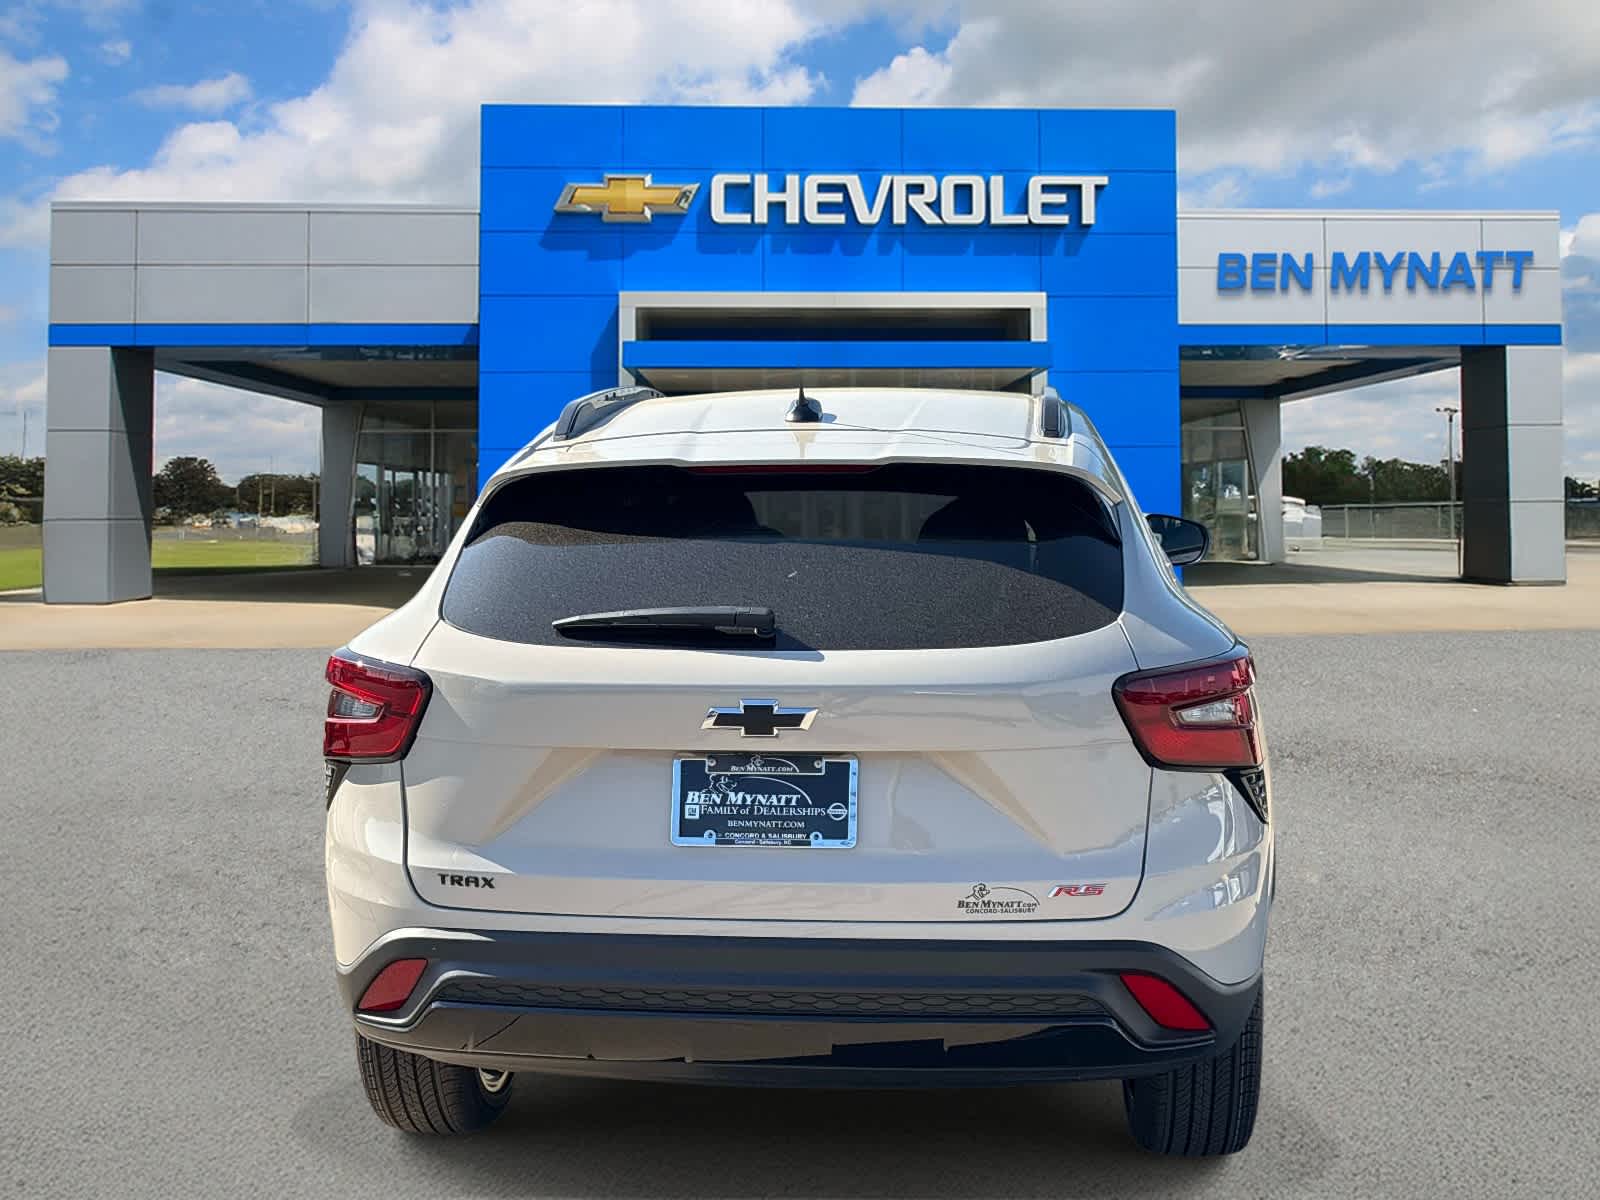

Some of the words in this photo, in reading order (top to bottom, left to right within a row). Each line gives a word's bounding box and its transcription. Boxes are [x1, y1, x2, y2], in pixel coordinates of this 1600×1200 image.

[710, 173, 1109, 225] CHEVROLET
[1217, 252, 1314, 290] BEN
[1330, 250, 1534, 290] MYNATT
[686, 791, 723, 804] BEN
[725, 791, 801, 806] MYNATT
[700, 805, 738, 815] FAMILY
[739, 805, 751, 815] of
[754, 805, 826, 816] DEALERSHIPS
[727, 820, 805, 828] BENMYNATT.COM
[437, 873, 496, 889] TRAX
[1048, 883, 1108, 897] RS
[957, 900, 981, 908] BEN
